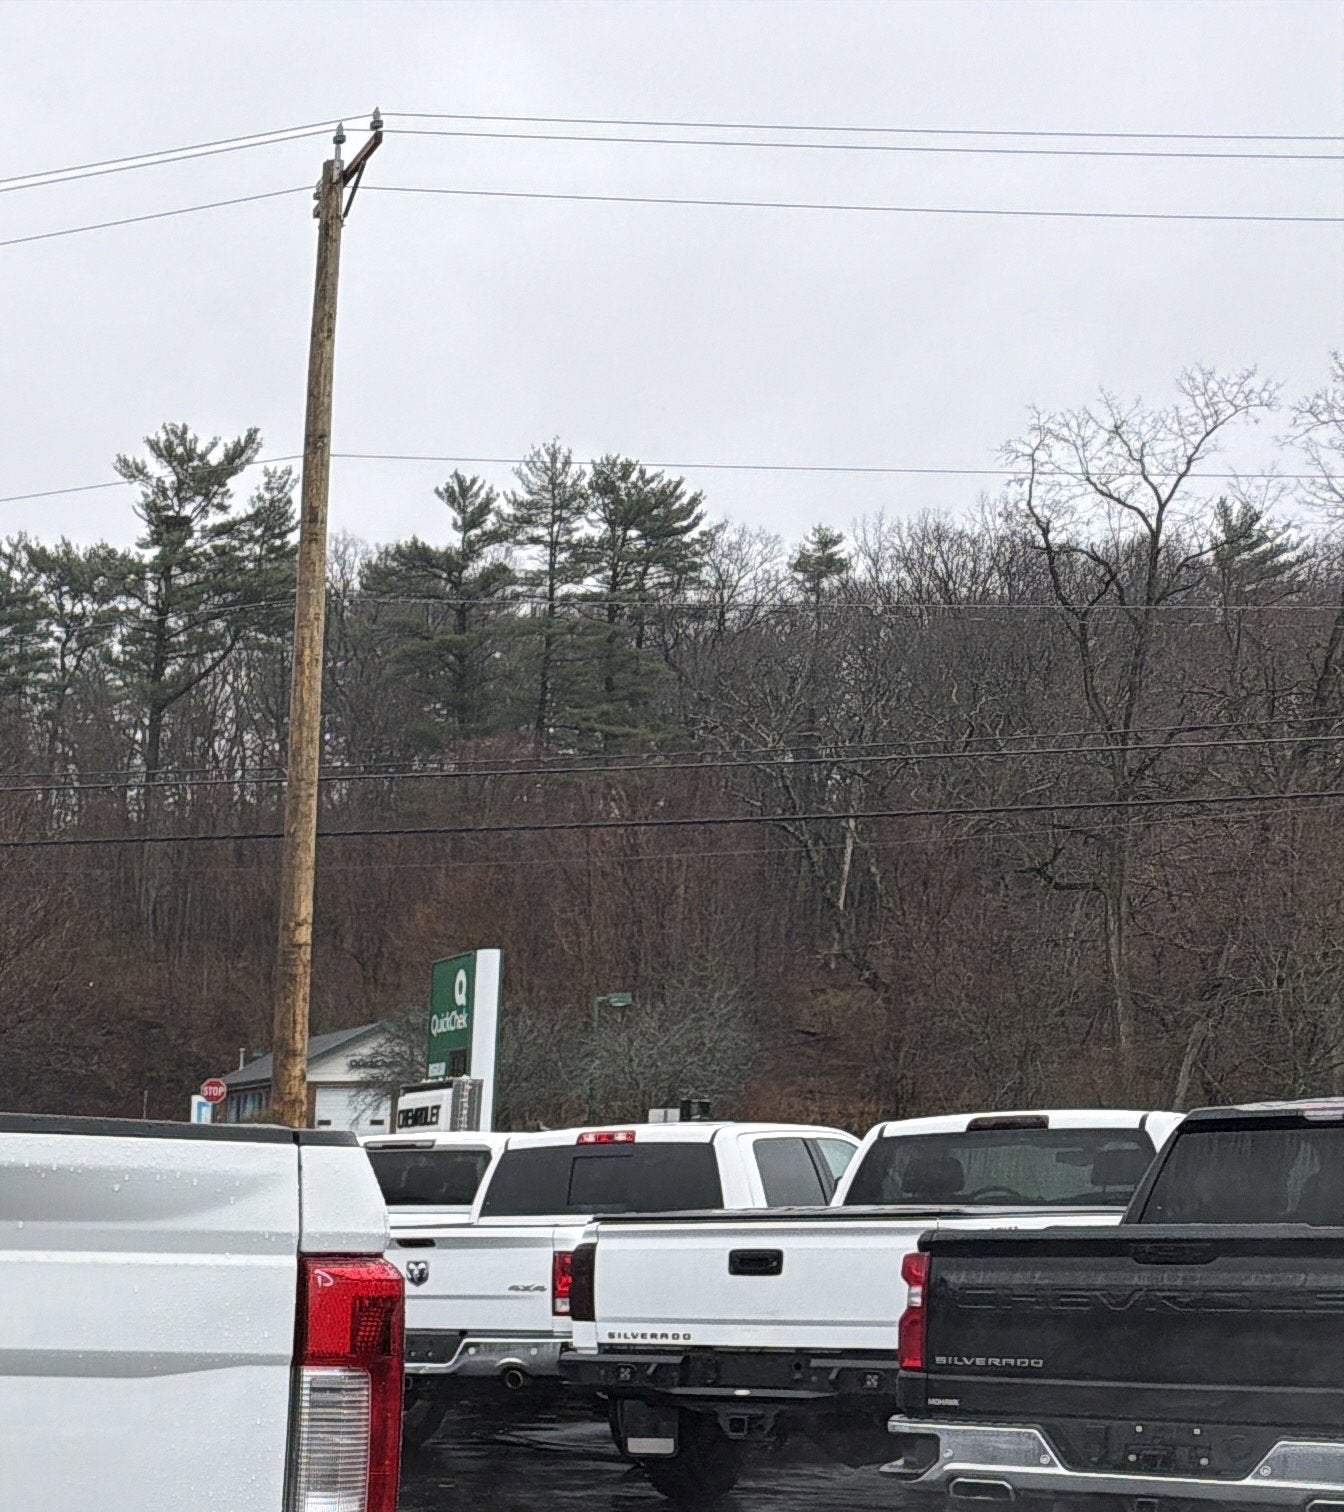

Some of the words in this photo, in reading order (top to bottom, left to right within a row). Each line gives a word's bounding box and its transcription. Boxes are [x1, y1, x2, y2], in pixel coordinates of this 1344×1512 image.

[202, 1086, 225, 1097] STOP
[607, 1331, 692, 1341] SILVERADO
[934, 1355, 1044, 1368] SILVERADO
